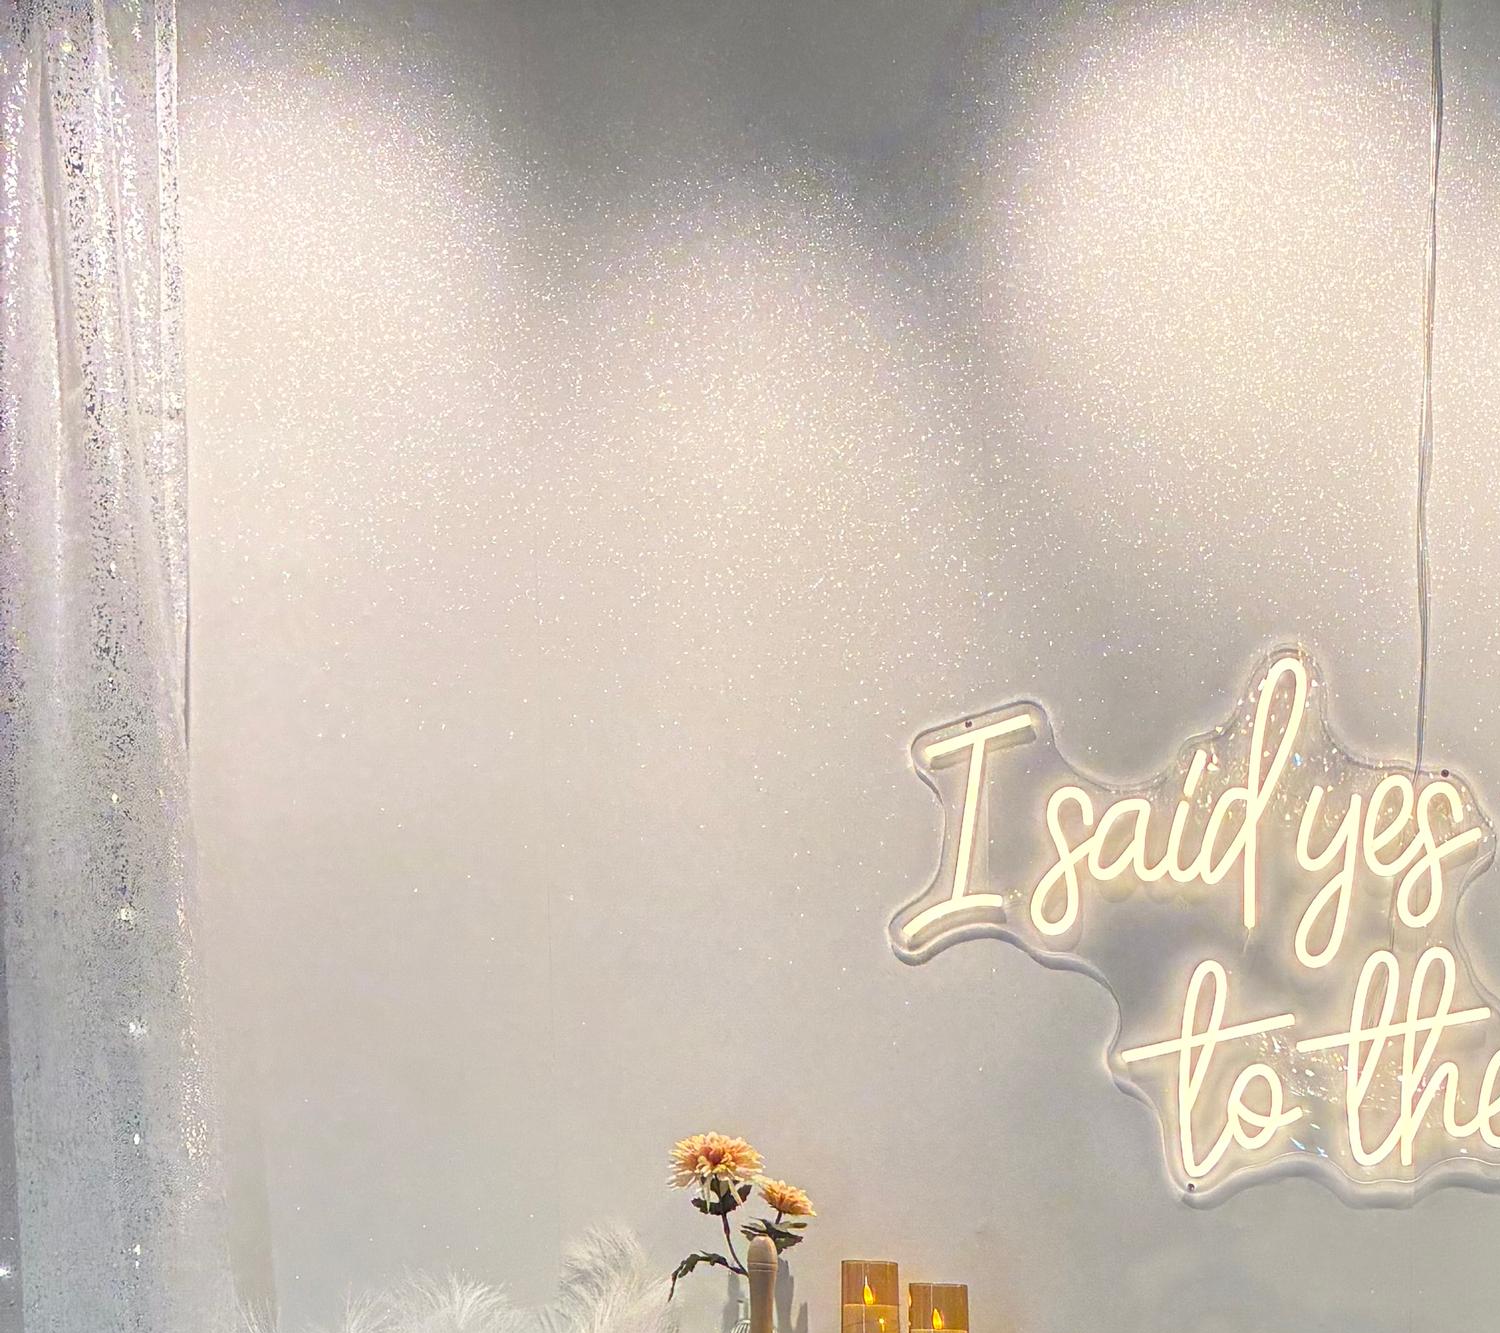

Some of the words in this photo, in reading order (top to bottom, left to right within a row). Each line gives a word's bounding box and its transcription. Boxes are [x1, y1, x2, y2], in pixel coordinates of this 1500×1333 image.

[902, 714, 1034, 939] I
[1028, 656, 1308, 937] said
[1292, 772, 1484, 969] yes
[1121, 958, 1304, 1178] to
